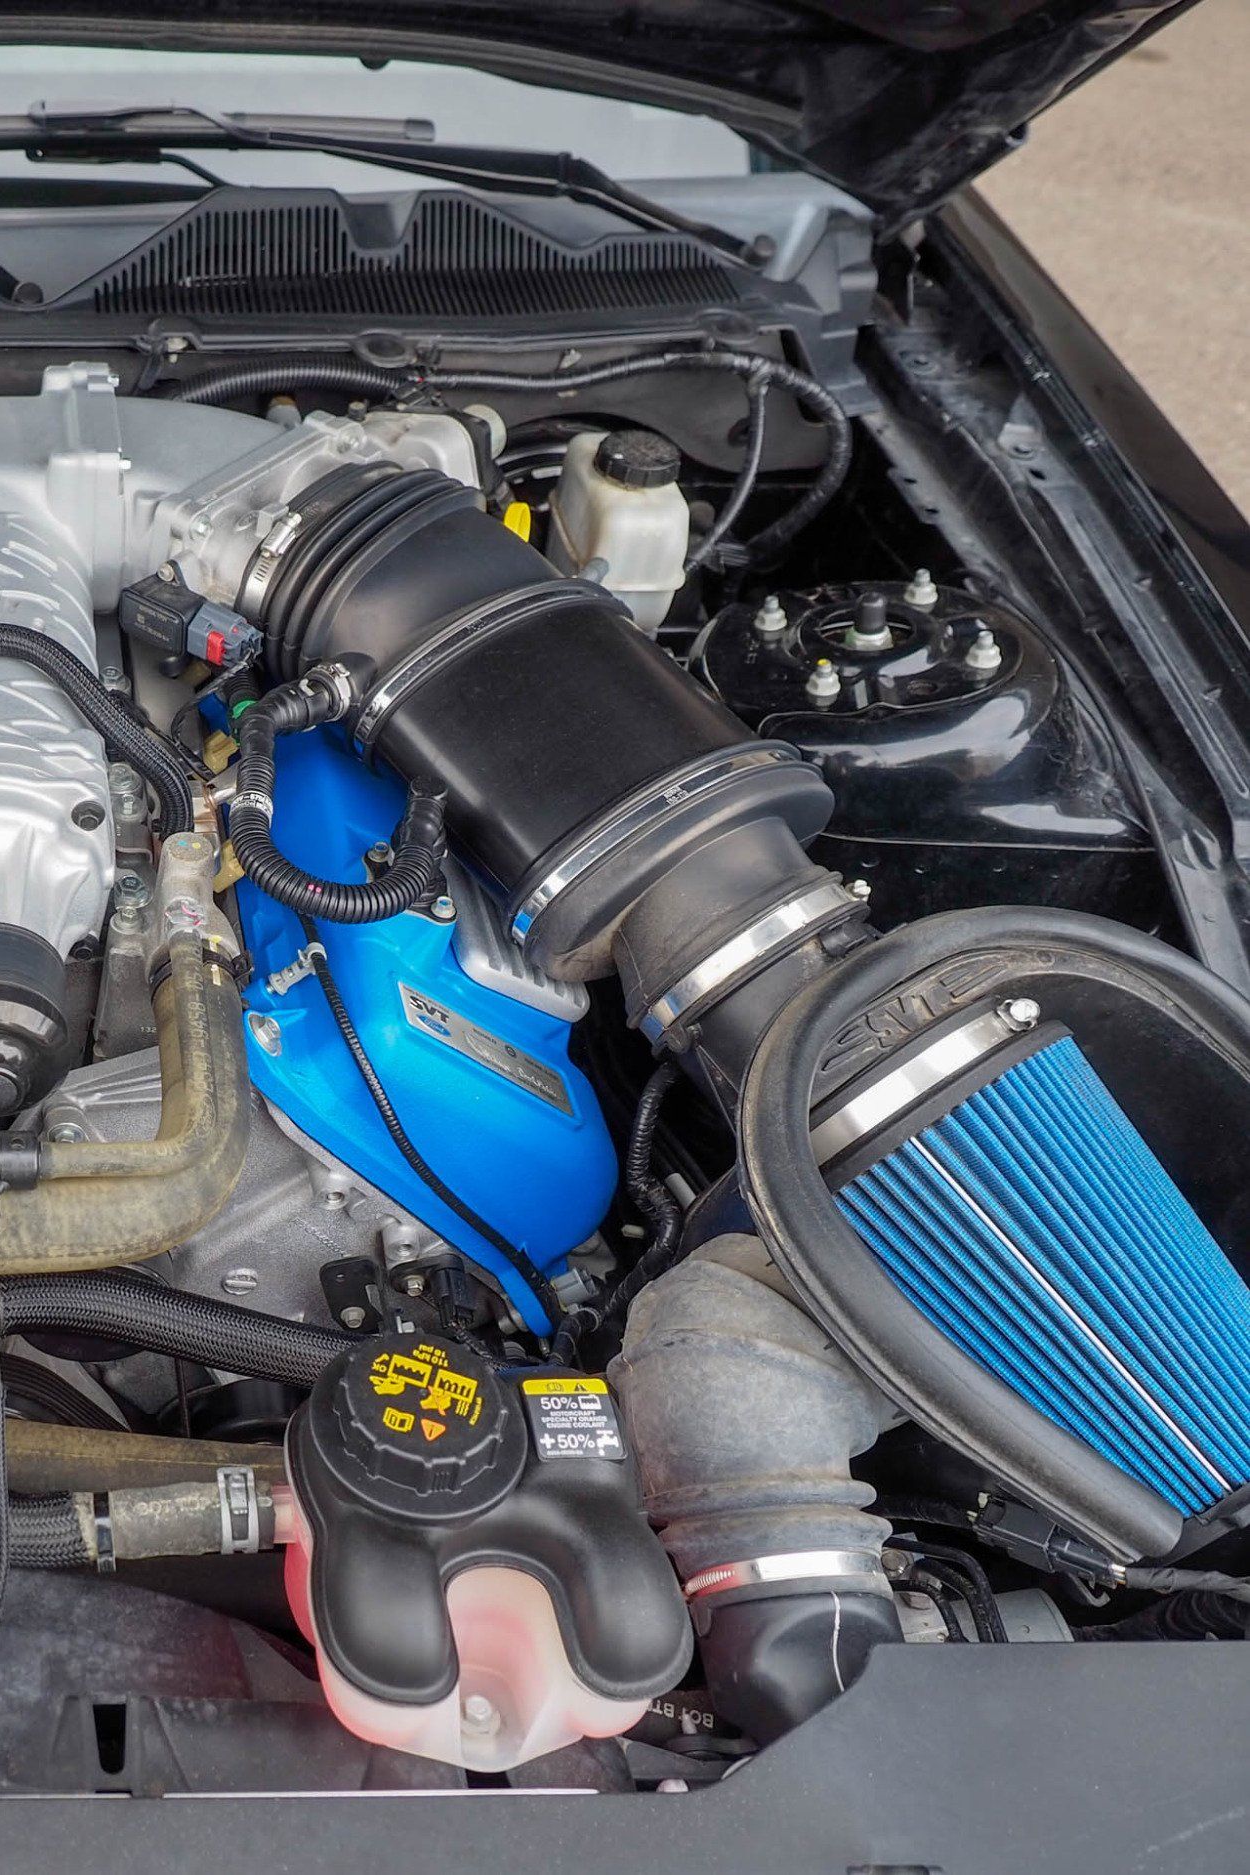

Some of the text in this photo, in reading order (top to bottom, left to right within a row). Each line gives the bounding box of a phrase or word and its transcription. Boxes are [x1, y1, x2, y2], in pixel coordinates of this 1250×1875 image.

[409, 995, 450, 1024] SVT
[431, 1356, 449, 1368] 110
[540, 1397, 578, 1410] 50%
